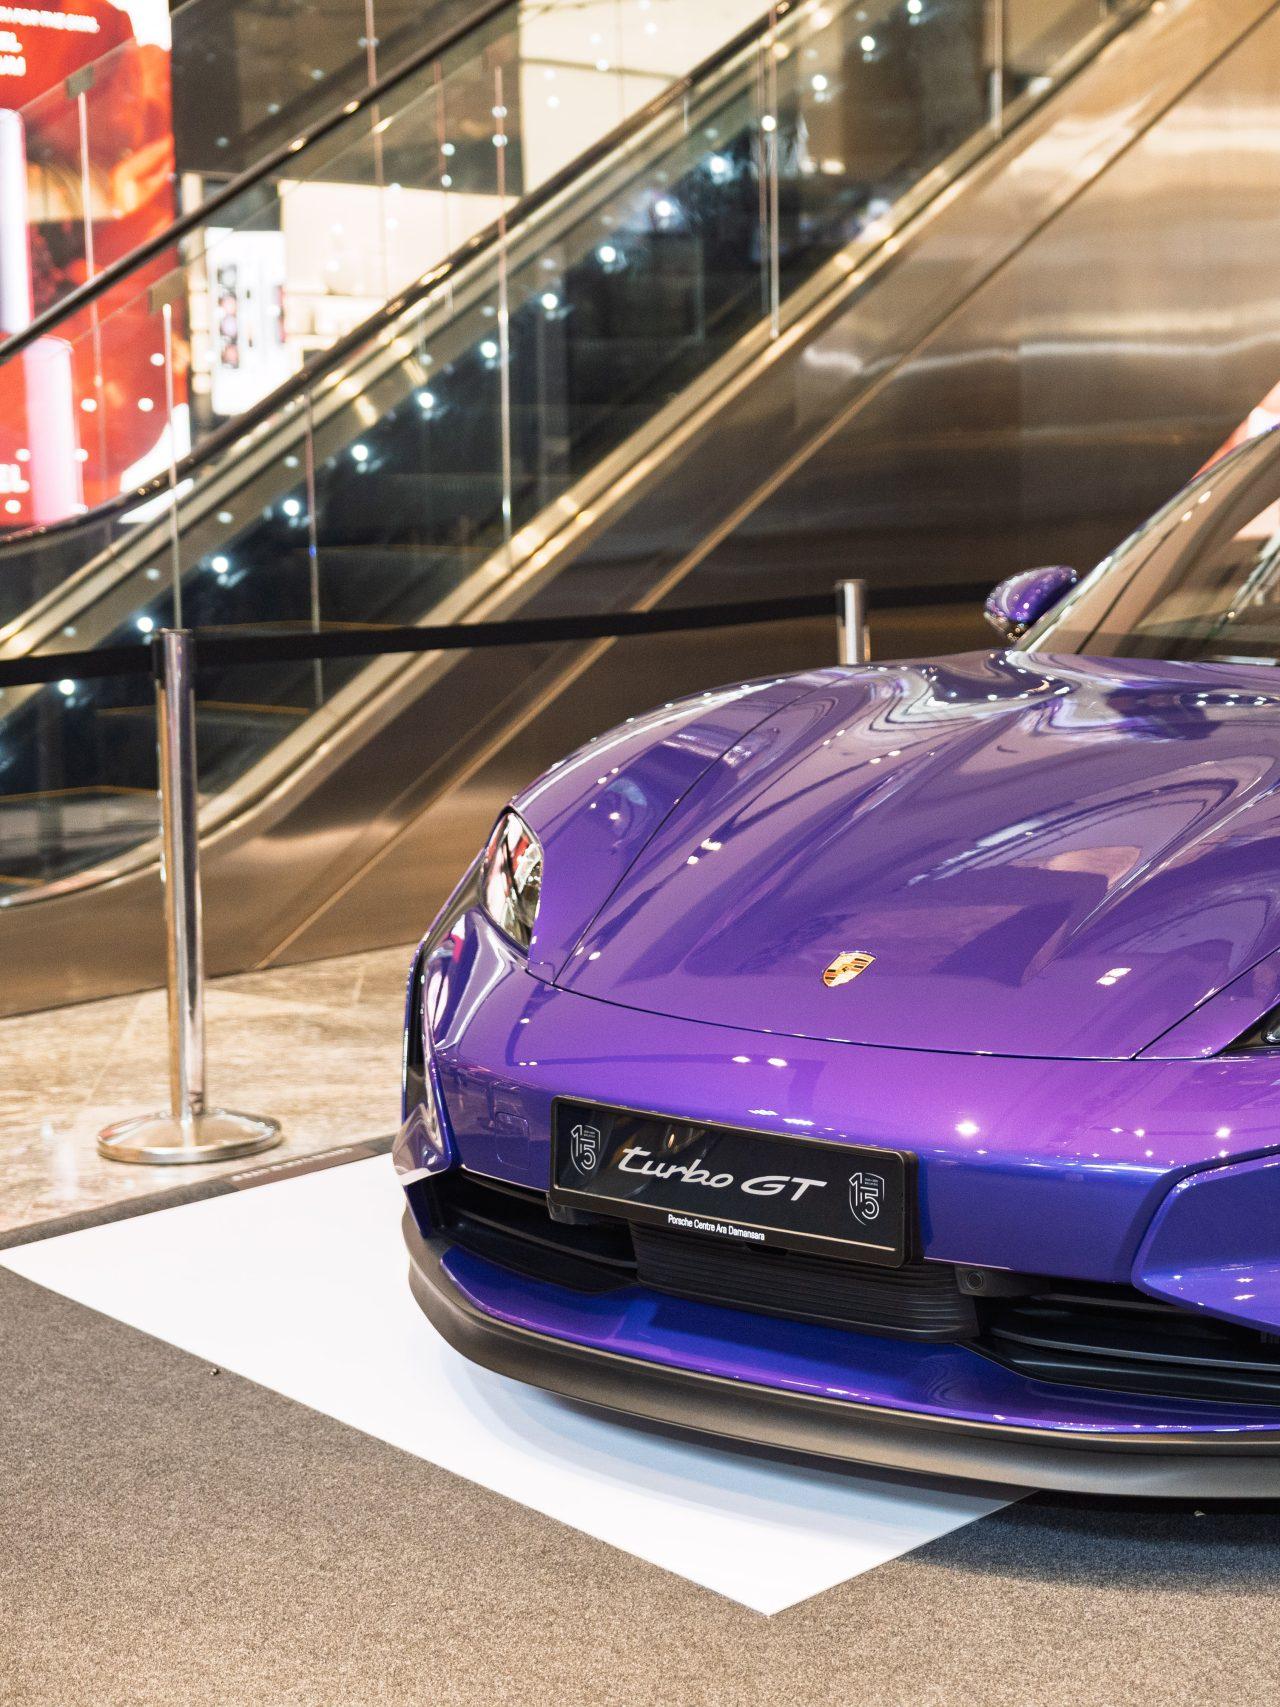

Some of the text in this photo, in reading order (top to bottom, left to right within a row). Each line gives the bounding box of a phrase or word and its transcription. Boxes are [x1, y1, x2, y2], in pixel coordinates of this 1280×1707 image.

[618, 1147, 828, 1202] turbo GT
[667, 1213, 765, 1241] Porsche Centre Ara Damansara
